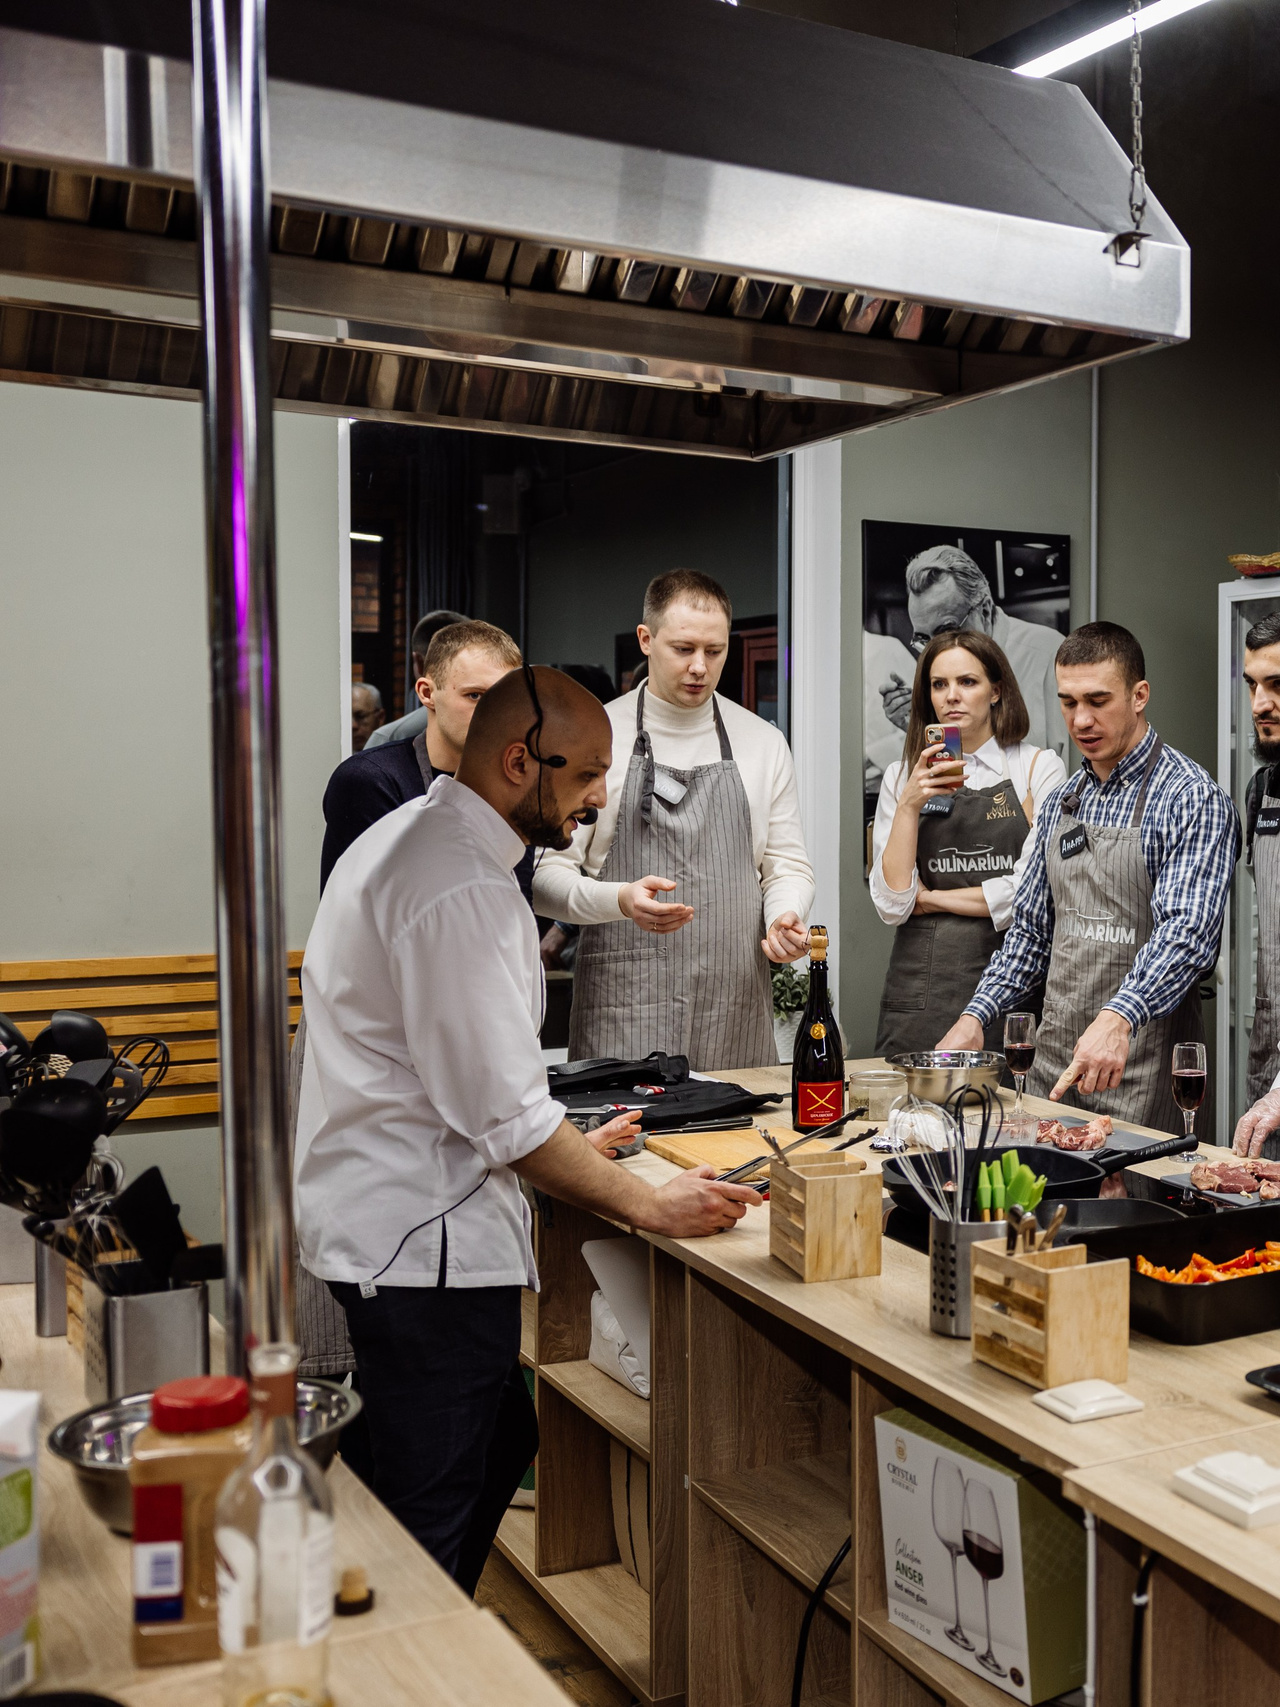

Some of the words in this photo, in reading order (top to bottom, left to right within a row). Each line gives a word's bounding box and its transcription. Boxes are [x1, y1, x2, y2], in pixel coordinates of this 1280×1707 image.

[986, 810, 1017, 821] КУХНИ
[887, 1462, 918, 1486] CRYSTAL
[895, 1560, 925, 1587] ANSER
